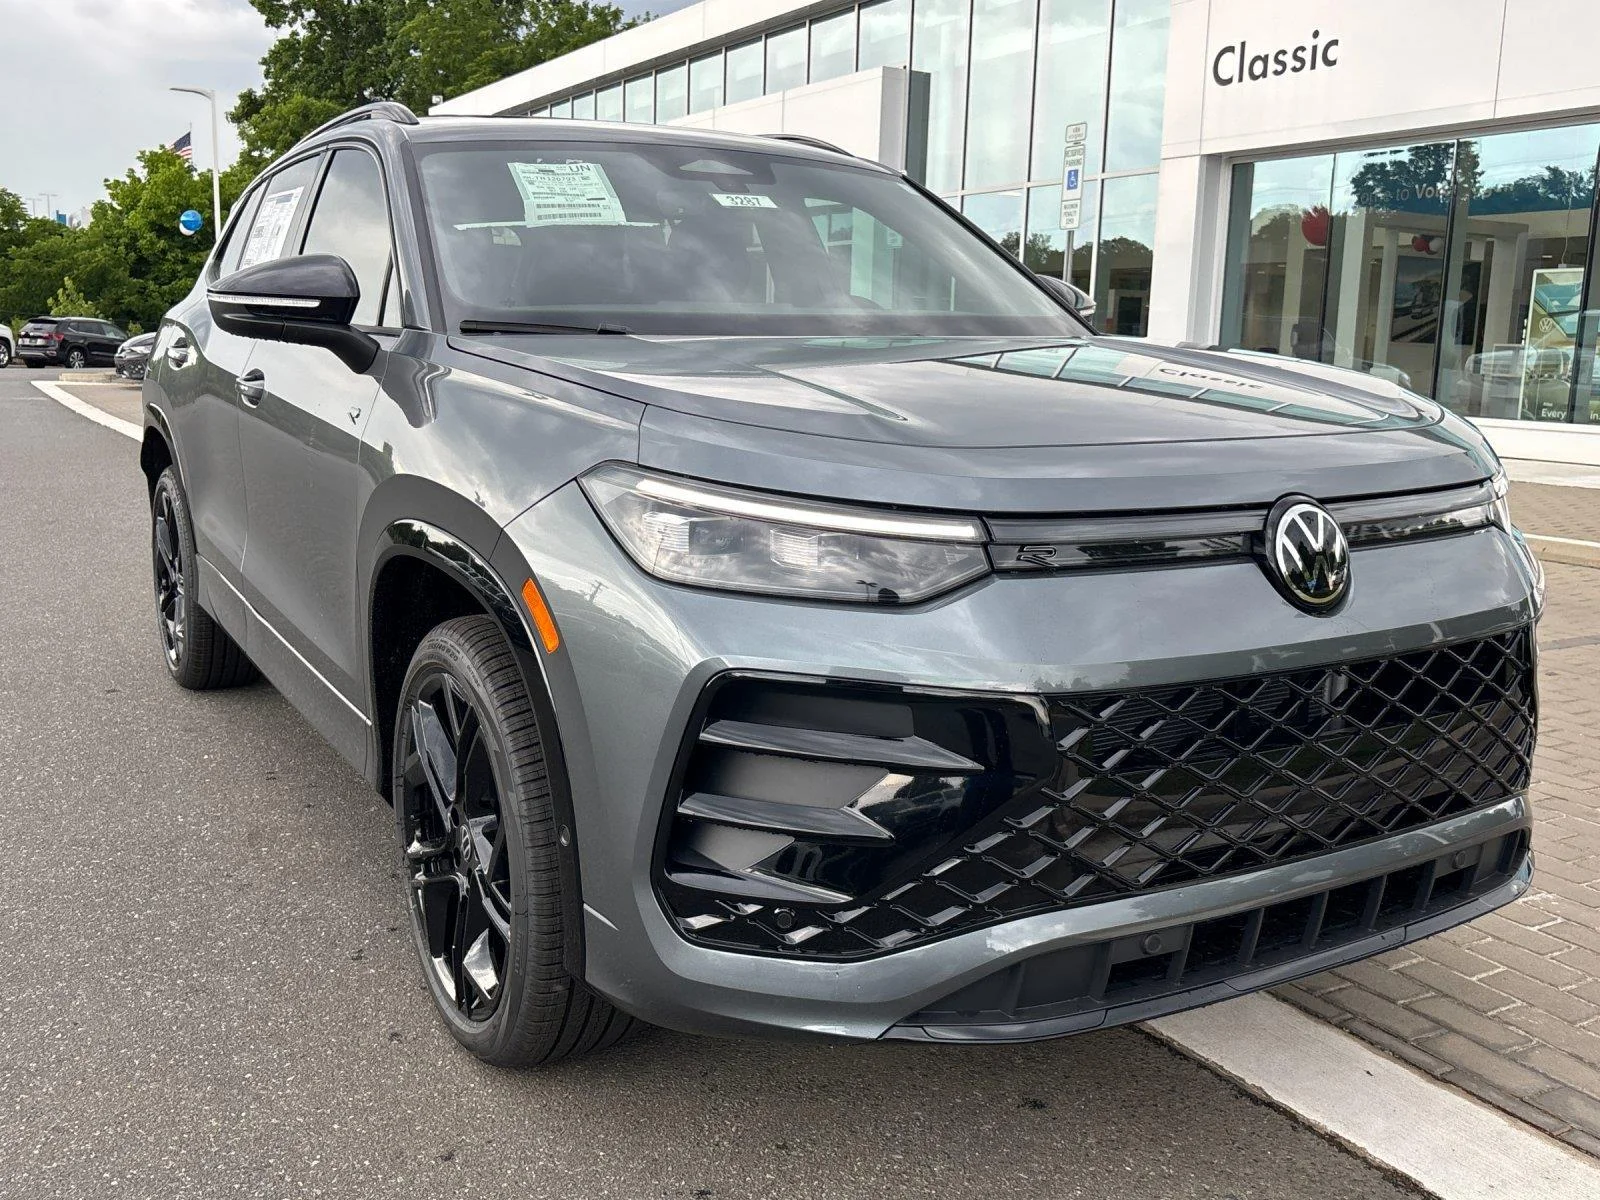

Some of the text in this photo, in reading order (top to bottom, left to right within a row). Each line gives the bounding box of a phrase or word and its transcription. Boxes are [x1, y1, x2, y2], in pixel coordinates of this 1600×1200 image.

[1213, 29, 1339, 86] Classic
[568, 164, 591, 173] UN
[726, 195, 761, 207] 3287
[1541, 408, 1567, 420] Every
